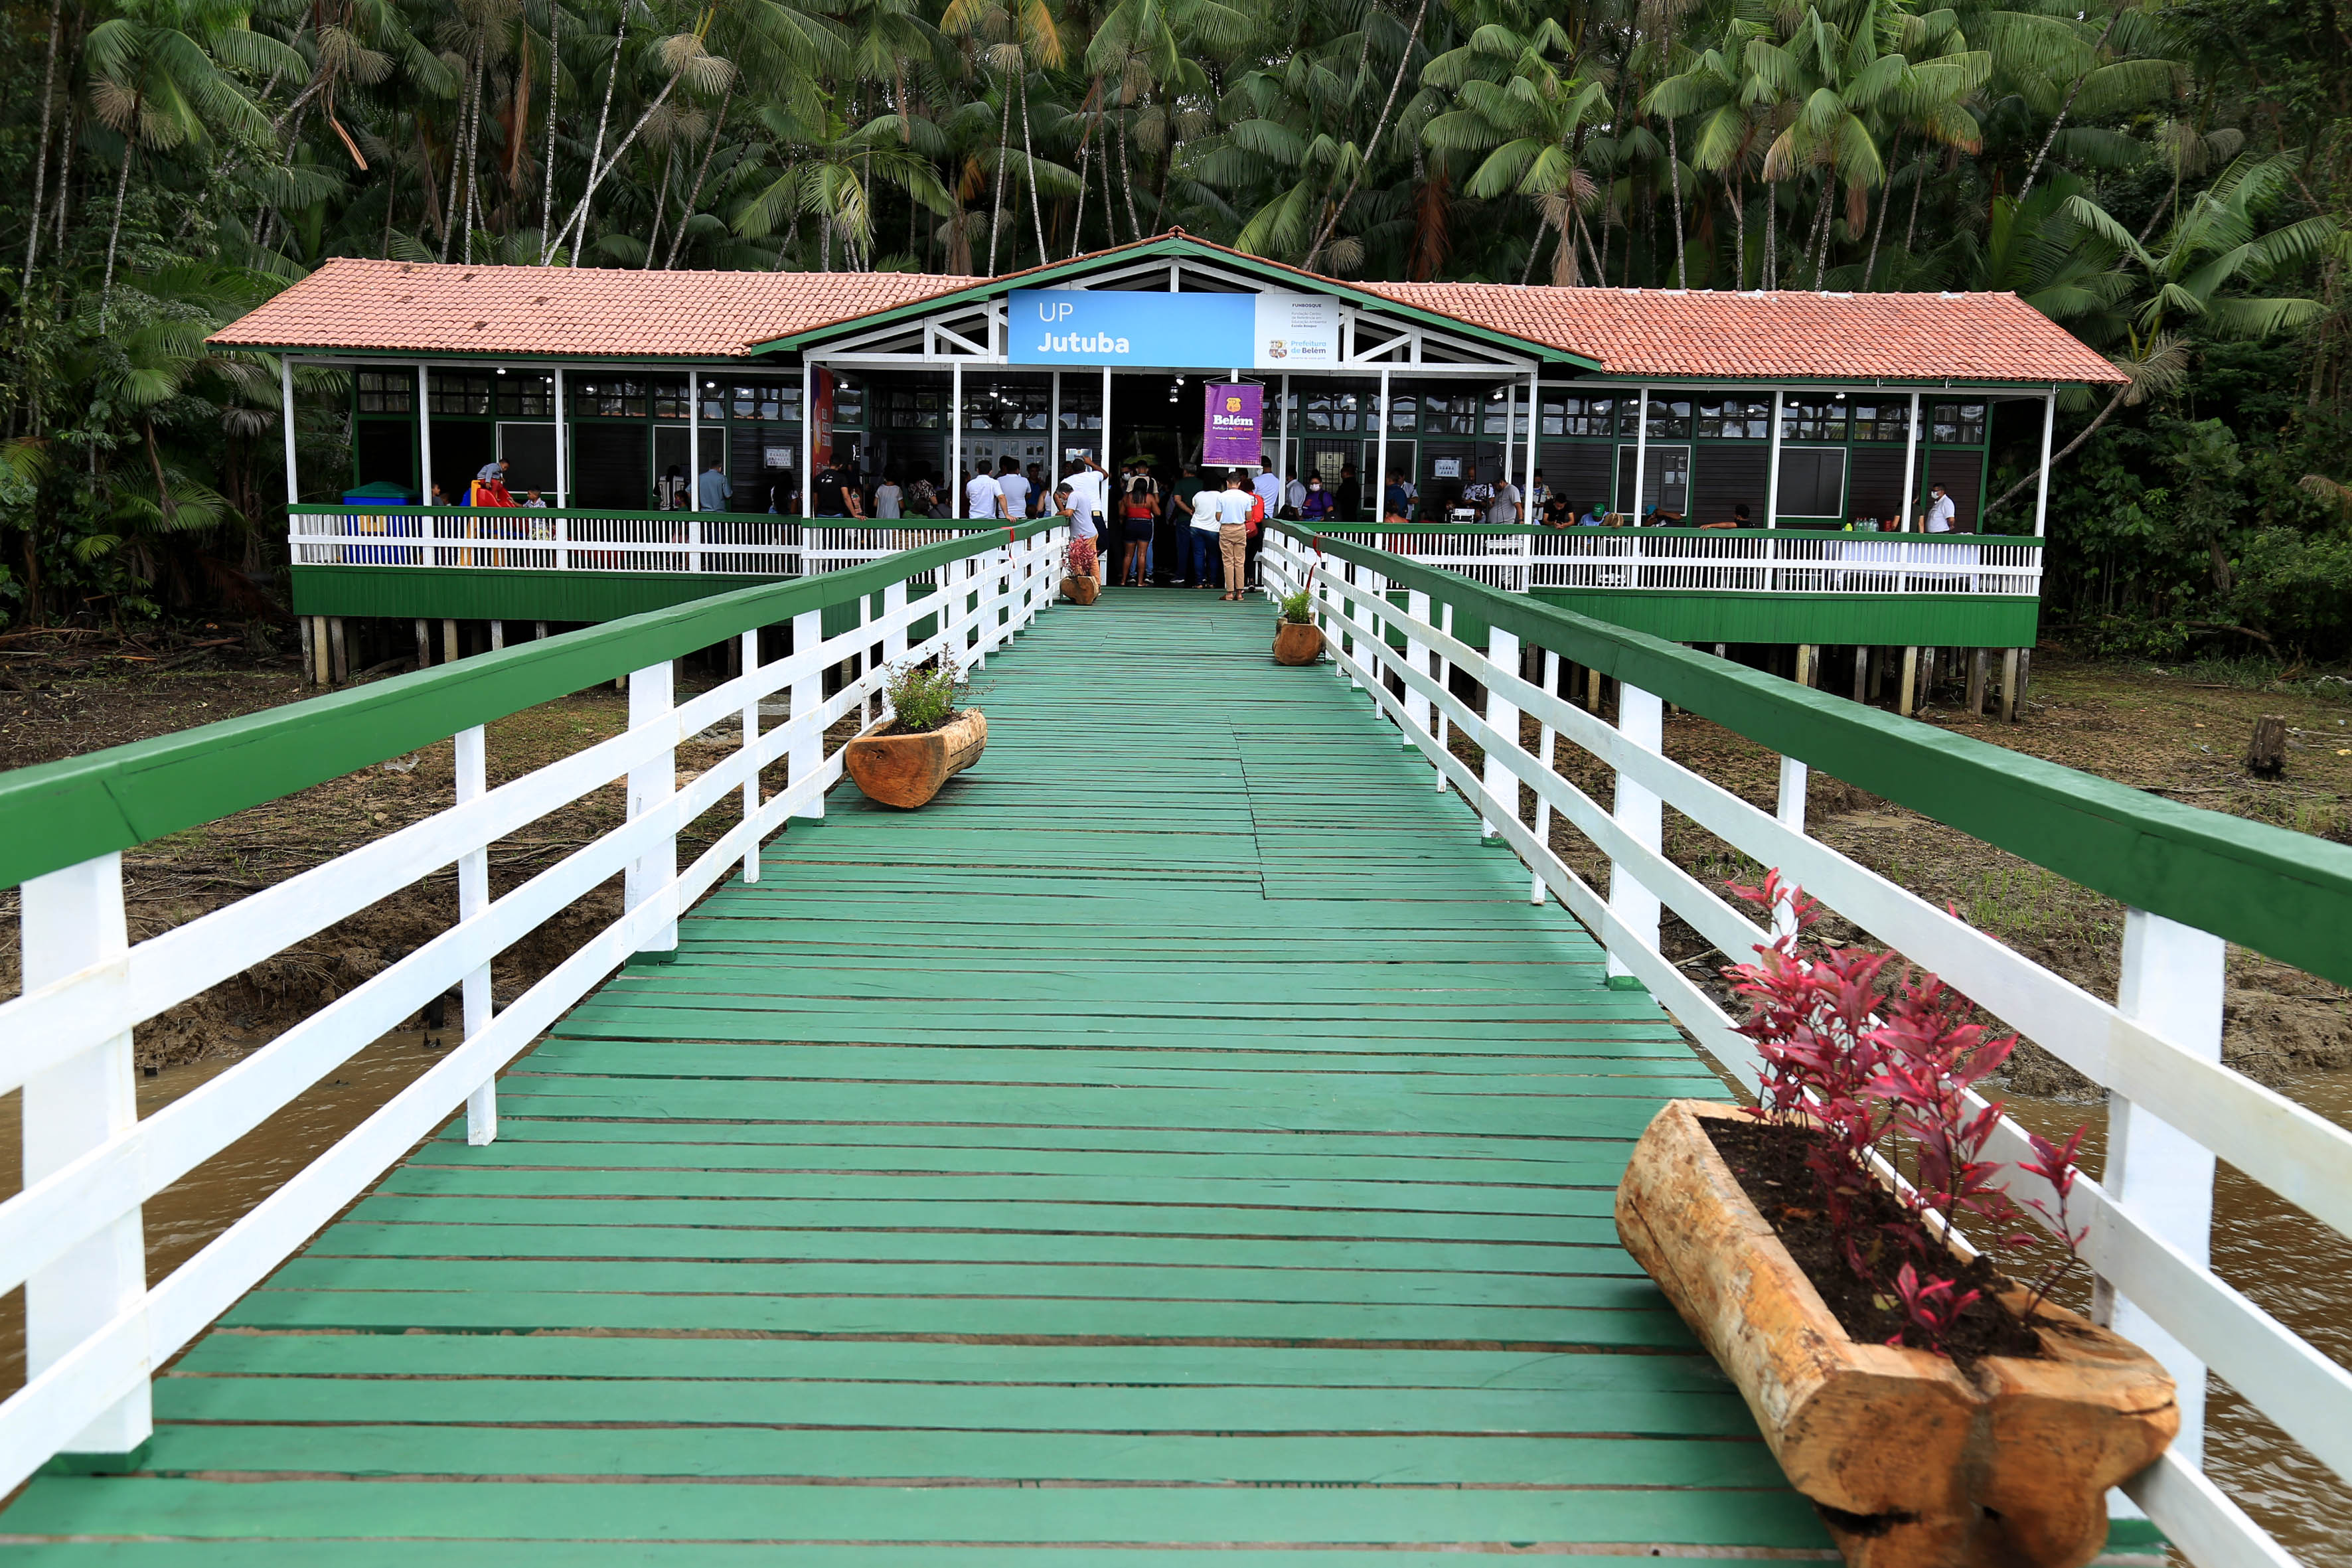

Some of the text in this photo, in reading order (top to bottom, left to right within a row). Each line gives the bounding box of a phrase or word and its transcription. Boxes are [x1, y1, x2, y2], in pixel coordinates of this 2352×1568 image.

[1039, 302, 1073, 322] UP
[1037, 332, 1130, 353] Jutuba
[1213, 414, 1254, 426] Belém
